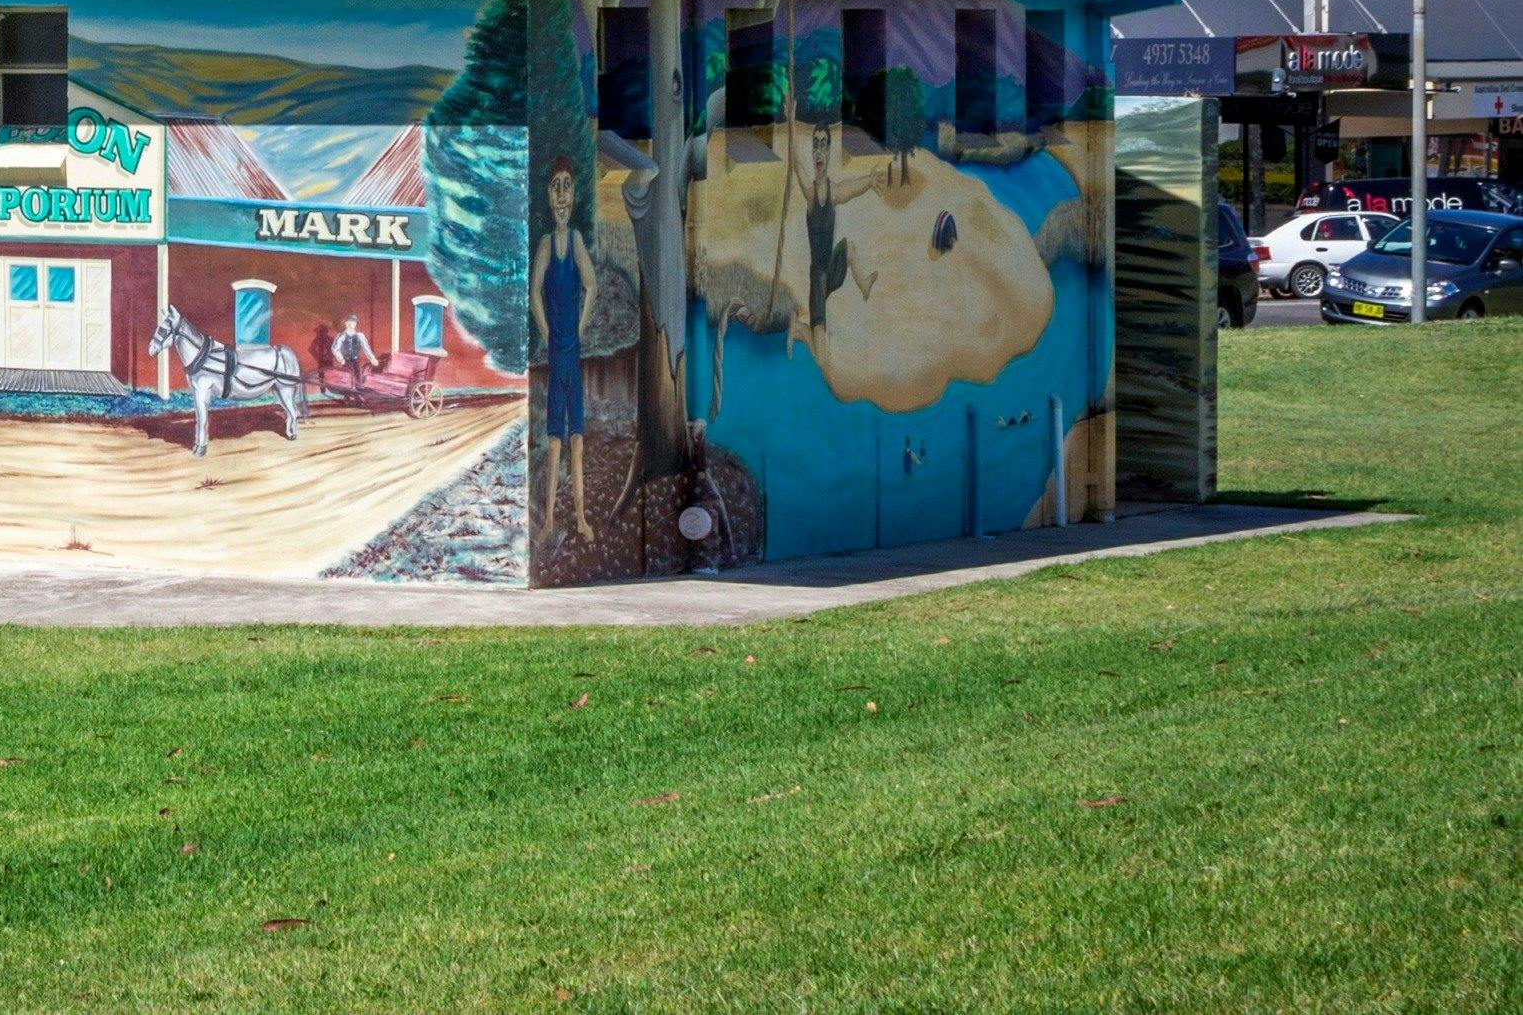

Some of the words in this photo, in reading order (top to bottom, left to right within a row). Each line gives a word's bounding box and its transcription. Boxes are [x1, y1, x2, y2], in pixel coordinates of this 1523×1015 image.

[1143, 44, 1175, 65] 4937
[1178, 44, 1210, 65] 5348
[1317, 44, 1364, 71] mode
[1347, 198, 1361, 211] a
[1366, 194, 1389, 211] la
[258, 208, 412, 246] MARK
